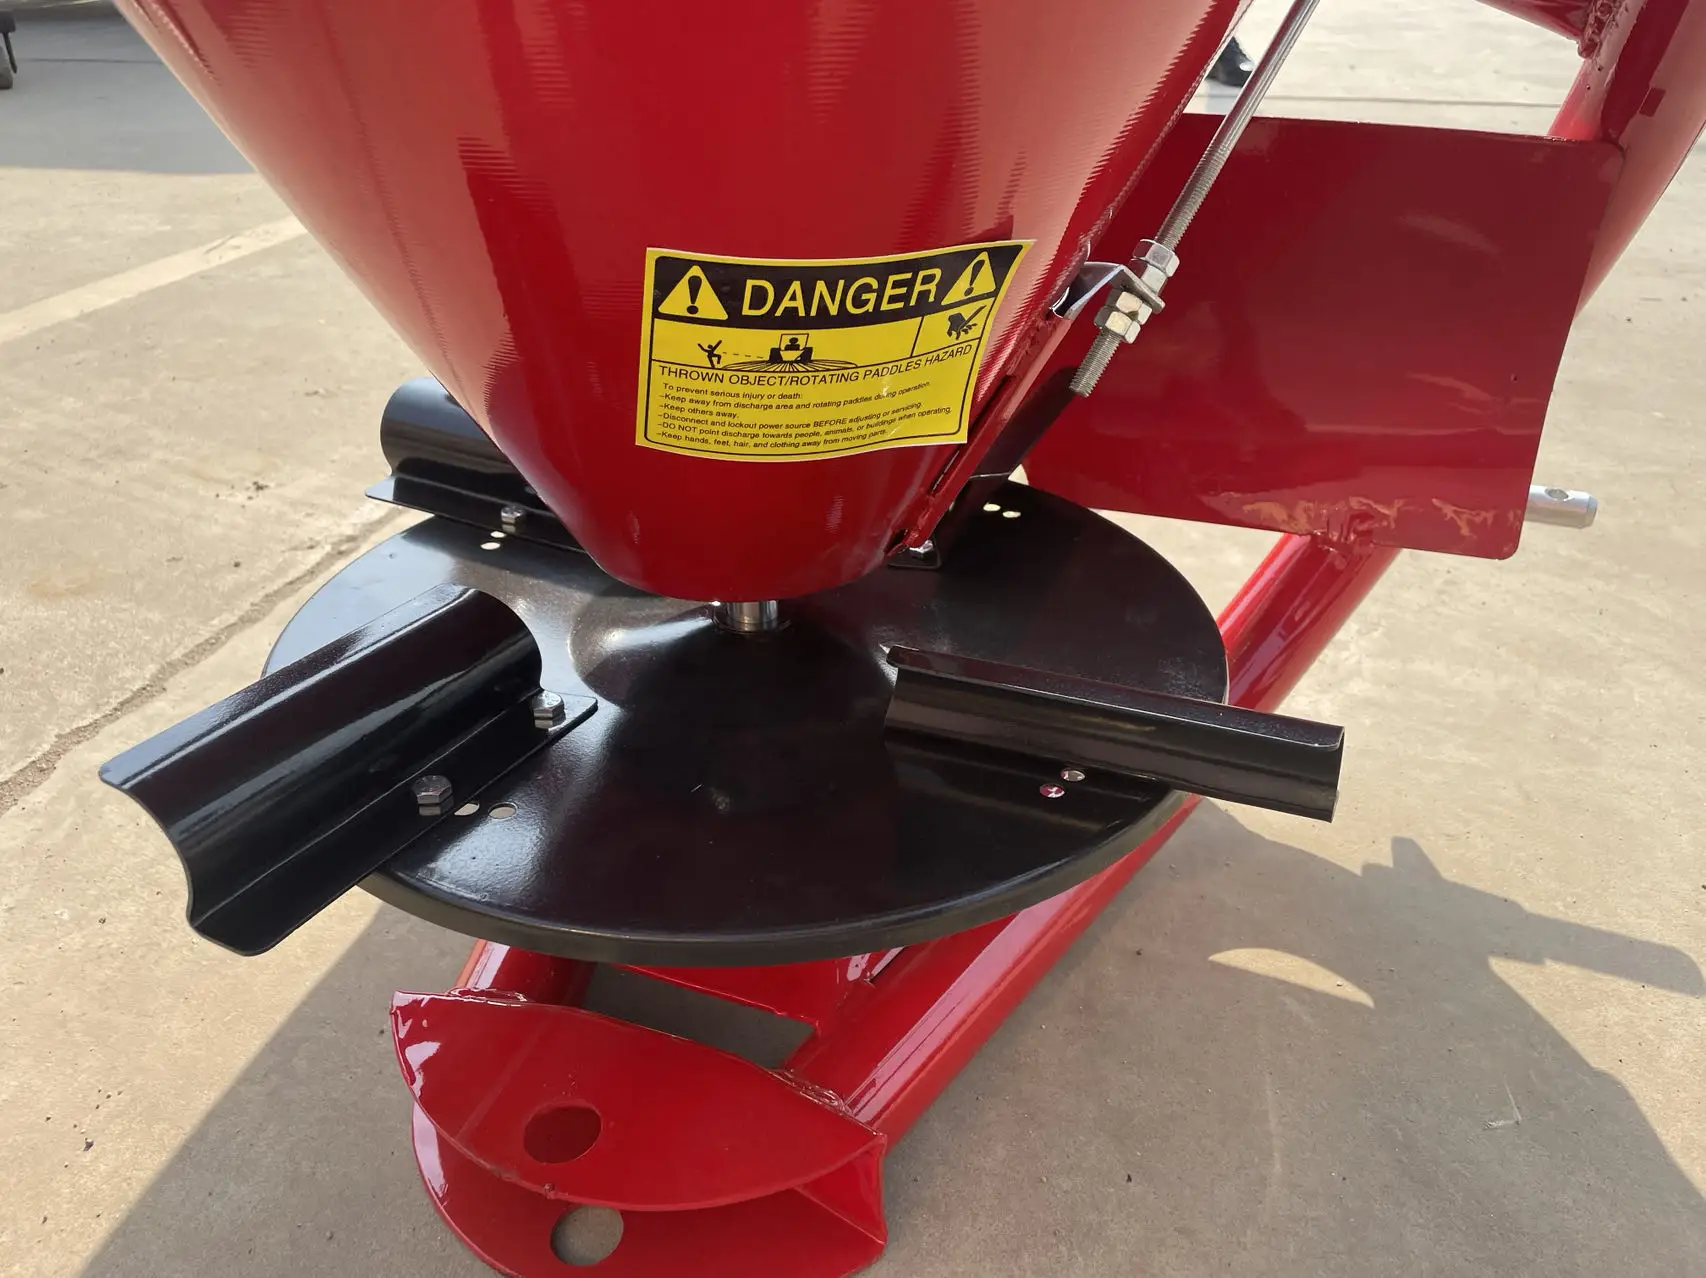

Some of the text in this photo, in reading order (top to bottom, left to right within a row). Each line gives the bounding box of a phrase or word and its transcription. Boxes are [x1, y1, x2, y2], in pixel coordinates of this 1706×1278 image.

[740, 268, 943, 318] DANGER
[659, 344, 972, 386] THROWN OBJECT/ROTATING PADDLES HAZARD
[663, 382, 674, 391] To
[676, 385, 708, 396] prevent
[710, 390, 740, 399] serious
[742, 391, 764, 401] injury
[689, 398, 711, 407] away
[712, 399, 732, 408] from
[733, 401, 773, 411] discharge
[795, 401, 811, 409] and
[812, 399, 842, 409] rotating
[843, 395, 872, 406] paddles
[687, 407, 713, 416] others
[715, 411, 739, 419] away.
[727, 421, 757, 429] lockout
[758, 422, 784, 431] power
[785, 421, 811, 429] source
[813, 417, 847, 428] BEFORE
[848, 411, 881, 424] adjusting
[678, 424, 697, 432] NOT
[699, 427, 719, 436] point
[721, 429, 760, 439] discharge
[762, 431, 793, 439] towards
[866, 418, 897, 430] buildings
[898, 412, 916, 421] when
[770, 440, 800, 449] clothing
[801, 440, 821, 448] away
[841, 433, 867, 444] moving
